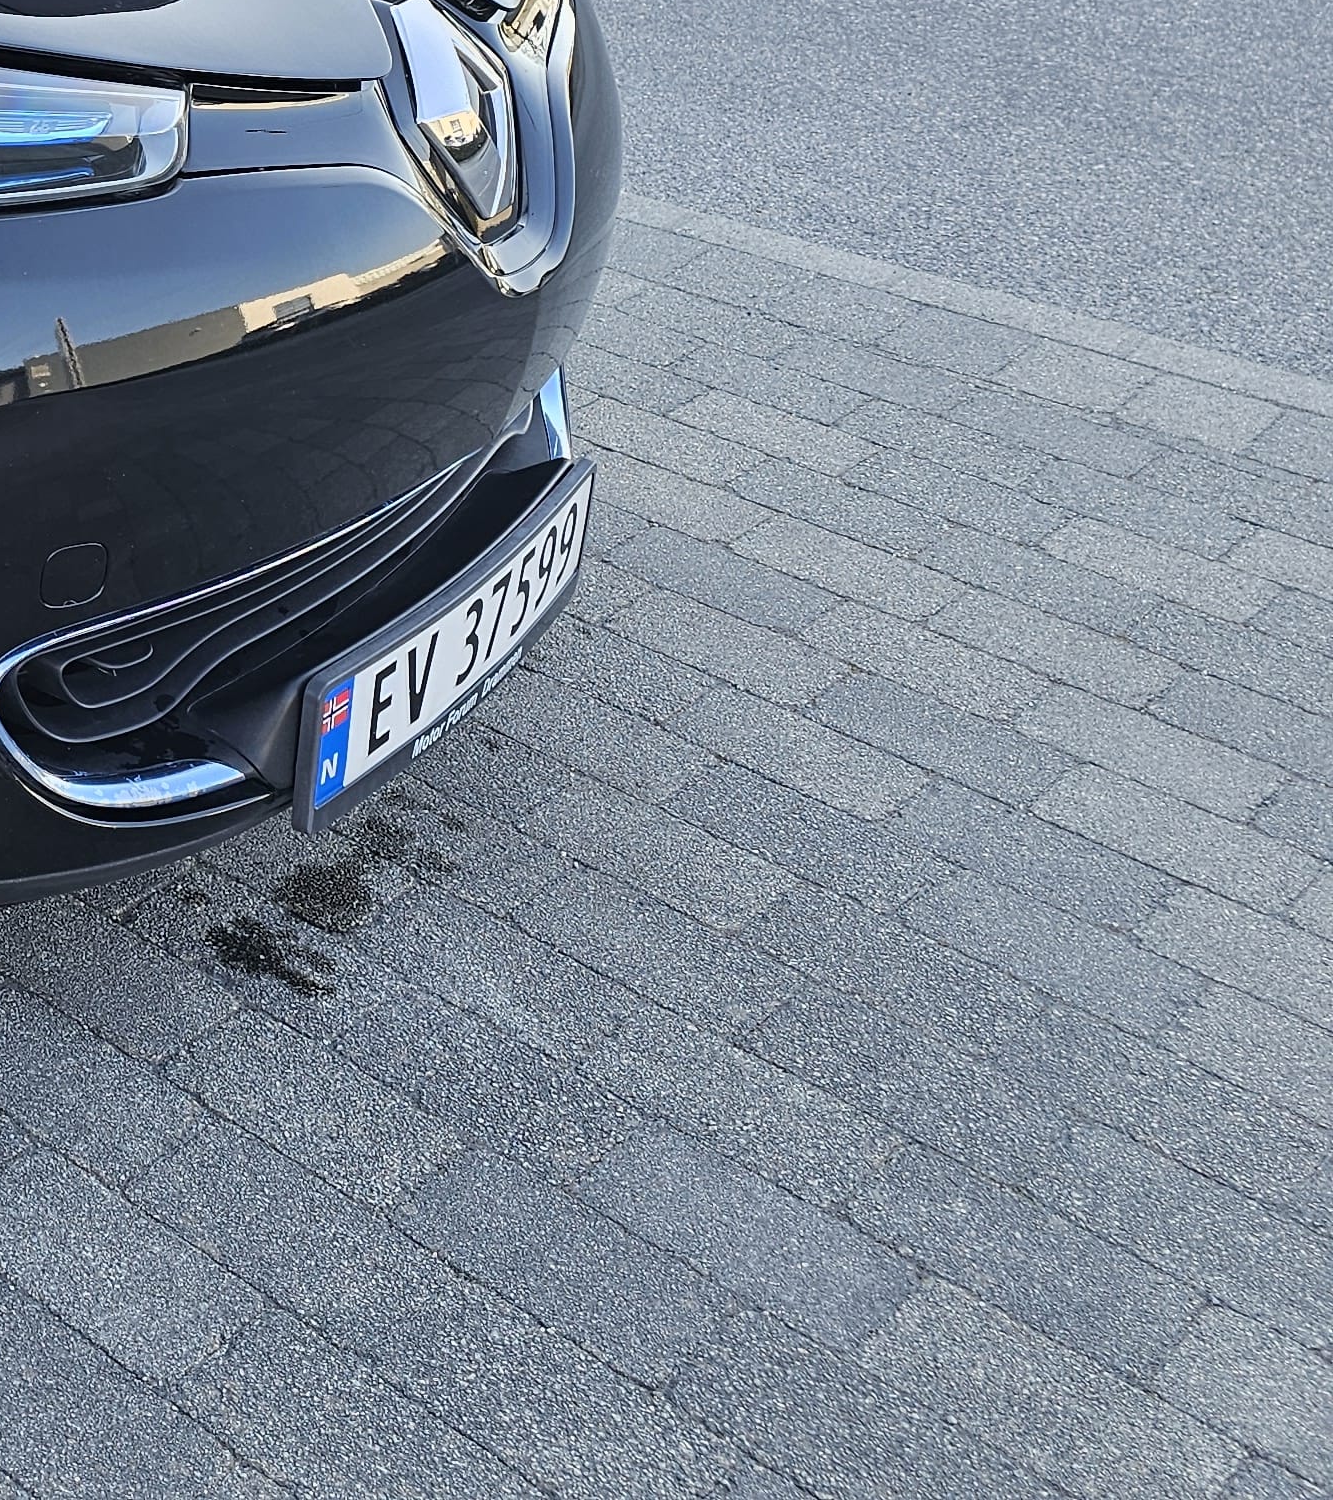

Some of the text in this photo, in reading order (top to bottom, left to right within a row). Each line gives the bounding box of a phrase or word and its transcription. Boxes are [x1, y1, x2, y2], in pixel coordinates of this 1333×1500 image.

[367, 502, 579, 757] EV 37599
[411, 721, 447, 759] Motor
[445, 692, 479, 732] Forum
[320, 752, 339, 786] N
